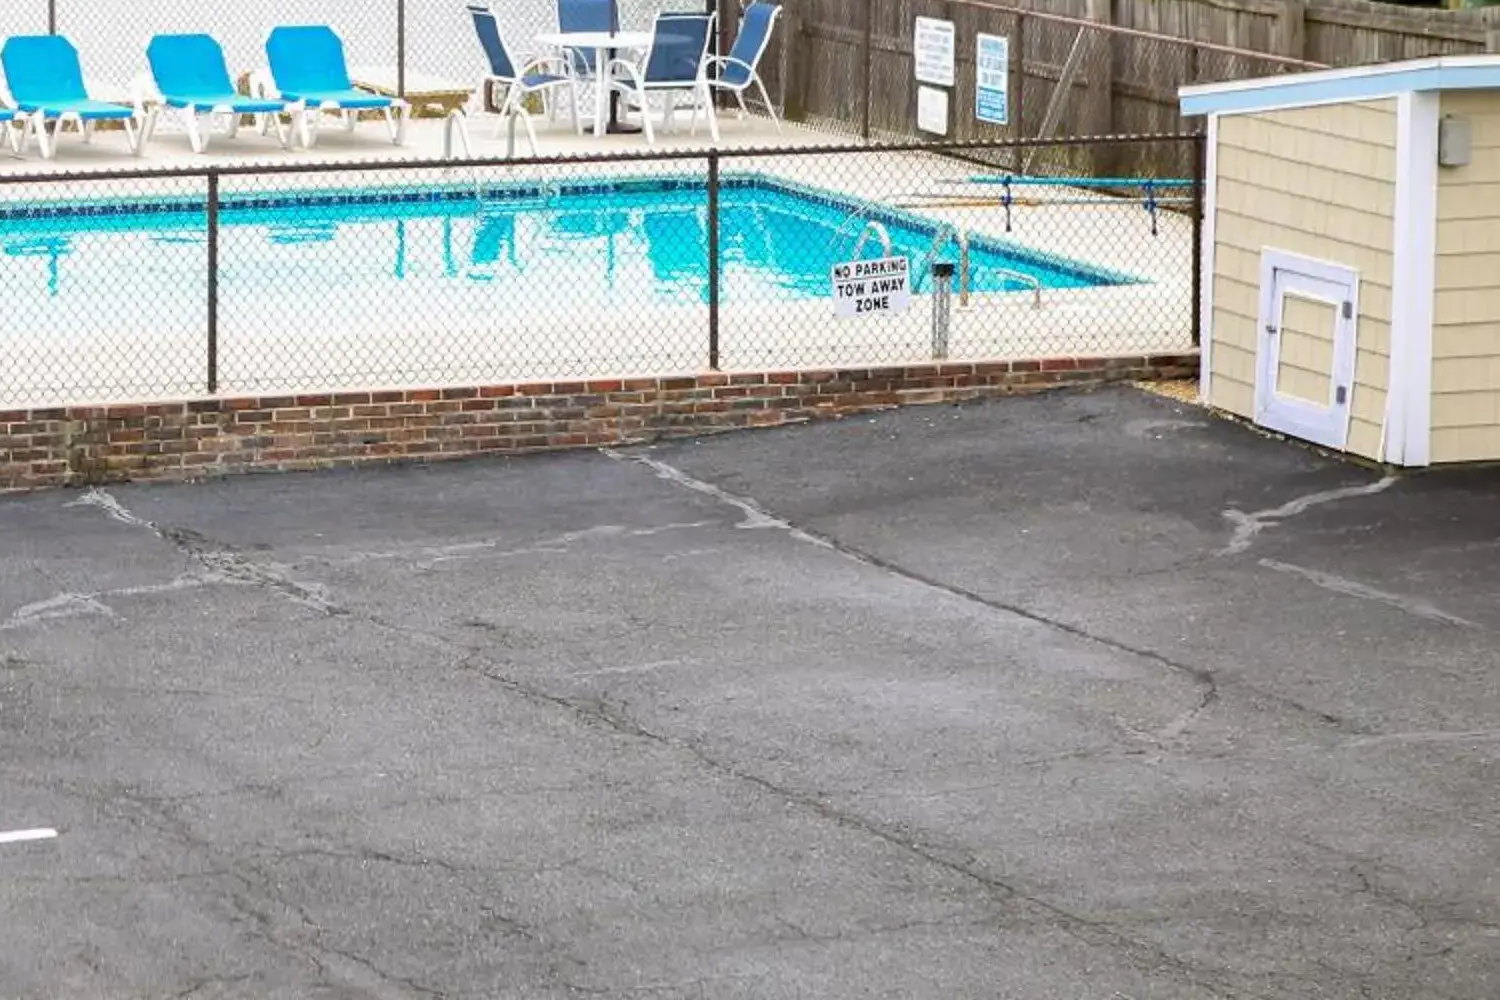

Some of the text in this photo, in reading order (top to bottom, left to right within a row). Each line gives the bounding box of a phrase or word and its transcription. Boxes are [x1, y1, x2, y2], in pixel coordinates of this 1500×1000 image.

[835, 259, 906, 278] NO PARKING
[838, 278, 904, 297] TOW AWAY
[856, 296, 889, 312] ZONE
